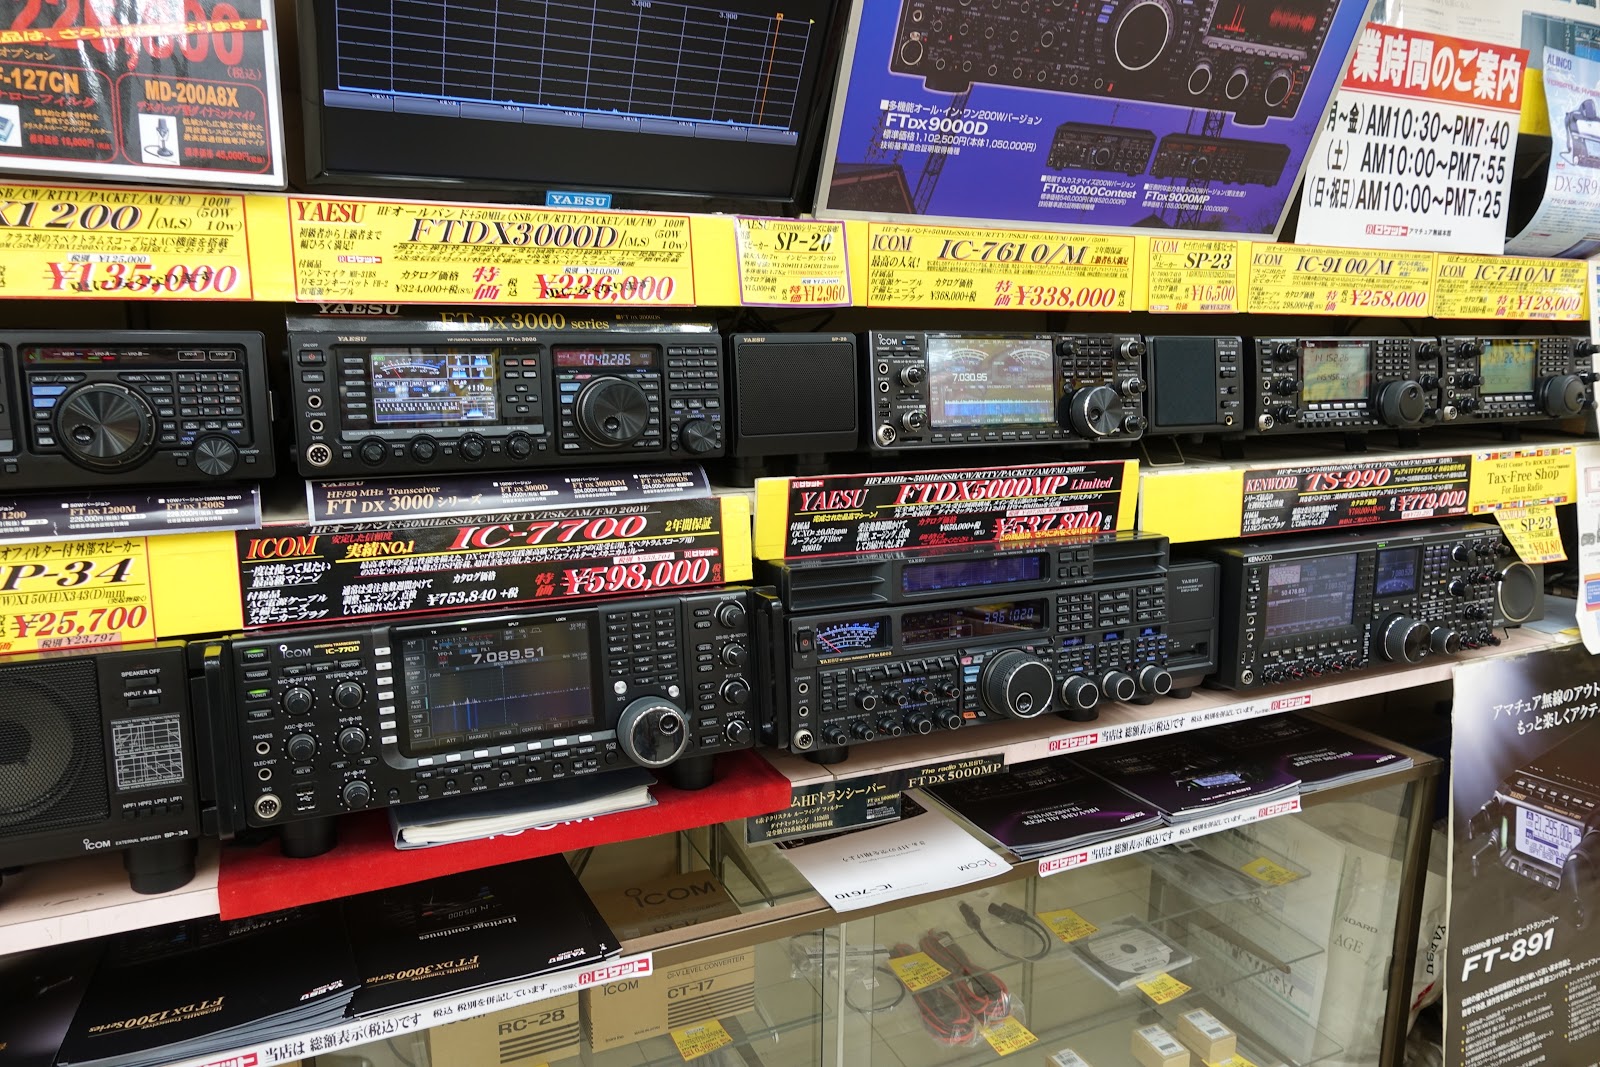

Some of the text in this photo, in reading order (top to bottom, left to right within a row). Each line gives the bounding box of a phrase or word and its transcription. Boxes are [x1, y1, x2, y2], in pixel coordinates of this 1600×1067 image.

[1343, 28, 1521, 103] 業時間のご案内
[1547, 54, 1572, 70] ALINCO
[0, 66, 80, 95] -127CN
[144, 79, 240, 108] MD-200A8X
[885, 113, 989, 136] FTDX9000D
[1326, 139, 1350, 171] (土)
[201, 197, 232, 206] 100W
[551, 194, 607, 207] YAESU
[296, 201, 366, 223] YAESU
[664, 219, 685, 228] 100W
[299, 226, 383, 241] 初級者から上級者まで
[655, 229, 681, 239] (50W
[775, 232, 832, 252] SP-20
[871, 234, 913, 251] ICOM
[937, 239, 1089, 265] IC-7610/M
[1152, 241, 1179, 252] ICOM
[871, 255, 920, 268] 最高の人気!
[1184, 252, 1233, 270] SP-23
[1253, 254, 1283, 266] ICOM
[1296, 256, 1394, 276] IC-9100/M
[401, 270, 459, 281] カタログ価格
[1438, 265, 1466, 277] ICOM
[1474, 266, 1556, 283] IC-7410/M
[934, 279, 973, 288] カタログ価格
[804, 286, 845, 302] ¥12,960
[1014, 285, 1116, 308] ¥338,000
[1191, 285, 1235, 302] ¥16,500
[1350, 290, 1427, 309] ¥258,000
[319, 303, 401, 315] YAESU
[1516, 296, 1581, 312] ¥128,000
[440, 312, 610, 330] FT DX 3000 series
[952, 373, 988, 382] 7.030.95
[1509, 461, 1523, 469] Come
[1246, 476, 1298, 492] KENWOOD
[1305, 468, 1391, 492] TS-990
[1487, 468, 1560, 485] Tax-Free Shop
[327, 486, 441, 498] HF/50 MHz Transceiver
[893, 476, 1113, 505] FTDX5000MP Limited
[1501, 483, 1543, 494] For Ham Radio
[325, 494, 482, 515] FT DX 3000 シリーズ
[619, 505, 650, 514] 200W
[800, 489, 869, 512] YAESU
[1398, 490, 1467, 512] ¥779,000
[70, 505, 137, 516] FT 1200M
[447, 515, 648, 550] IC-7700
[664, 516, 713, 532] 2年間保証
[992, 511, 1102, 541] ¥537800
[1520, 516, 1552, 532] SP-23
[246, 536, 319, 559] ICOM
[1533, 539, 1560, 555] ¥9,180
[1248, 555, 1272, 563] KENWOOD
[0, 558, 132, 591] P-34
[561, 557, 710, 596] ¥598,000
[427, 588, 496, 606] ¥753,840
[10, 605, 148, 638] ¥25,700
[66, 633, 115, 645] ¥23,797
[325, 646, 360, 655] IC-7700
[471, 646, 545, 665] 7.089.51
[1493, 682, 1600, 720] アマチュア無線のアウト
[1517, 703, 1600, 735] もっと楽しくアクテ
[1101, 718, 1186, 743] 当店は 総額表示(税込)です
[254, 759, 277, 767] ELEC-KEY
[938, 765, 956, 774] radio
[958, 759, 984, 769] YAESU
[908, 762, 1002, 788] FT DX 5000MP
[140, 835, 162, 843] SPEAKER
[164, 829, 189, 839] SP-34
[1091, 849, 1112, 860] 当店は
[834, 883, 893, 900] IC-7610
[418, 914, 518, 942] Heritage continues
[1334, 932, 1363, 954] AGE
[1426, 924, 1446, 976] YAESU
[1461, 928, 1555, 982] FT-891
[366, 955, 479, 985] FT DX 3000 Series
[667, 955, 745, 980] CI-V LEVEL CONVERTER
[667, 979, 714, 999] CT-17
[88, 996, 225, 1033] FT DX 1200 Series
[265, 1042, 306, 1061] 当店は
[310, 1013, 422, 1053] 総額表示(税込)です
[433, 1007, 454, 1018] 税込
[457, 983, 548, 1012] 税別を併記しています
[498, 1009, 566, 1036] RC-28
